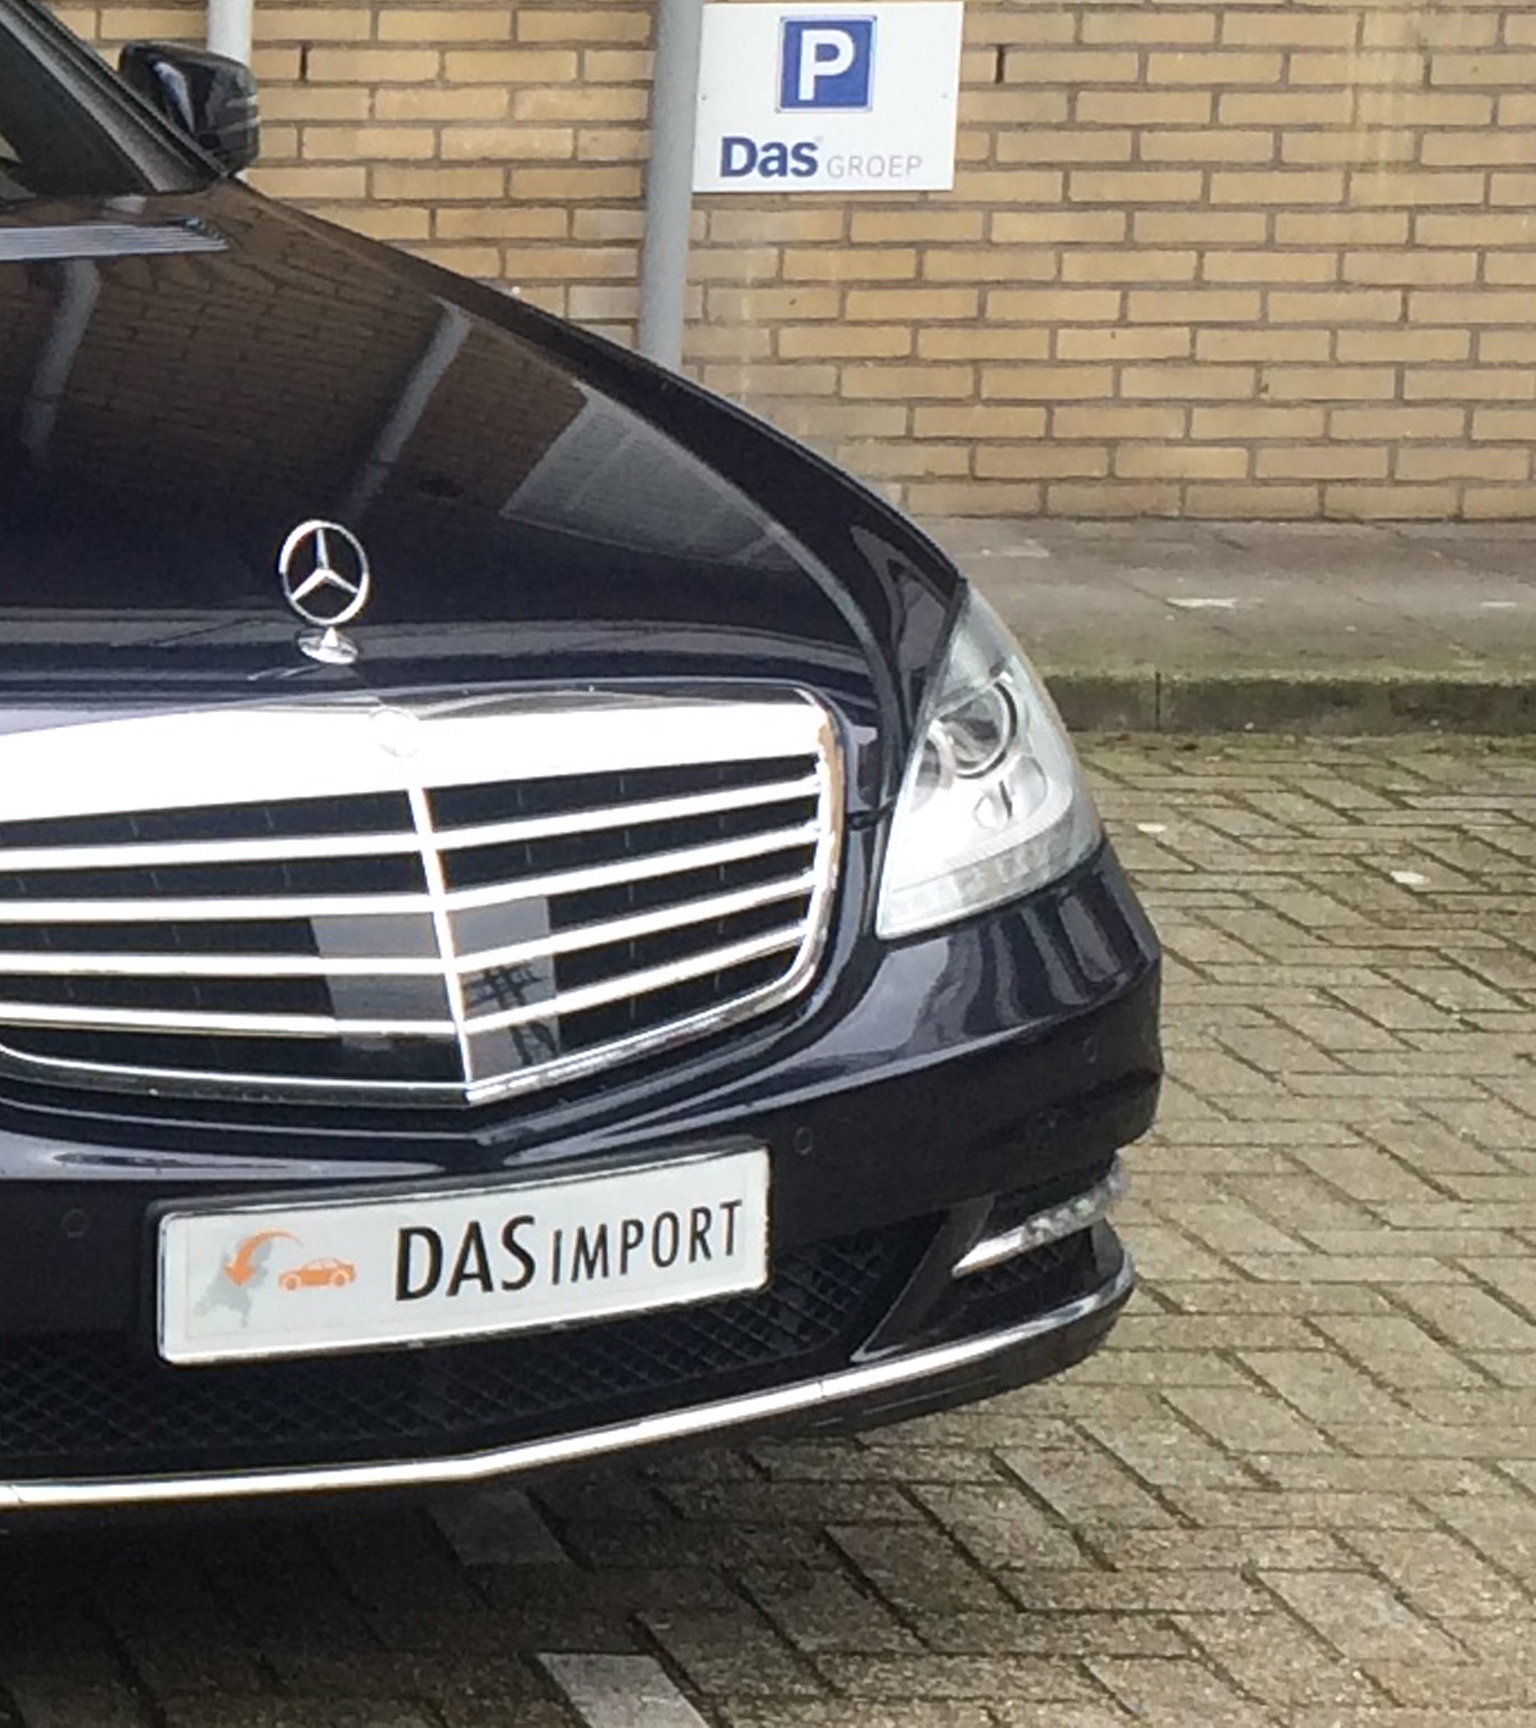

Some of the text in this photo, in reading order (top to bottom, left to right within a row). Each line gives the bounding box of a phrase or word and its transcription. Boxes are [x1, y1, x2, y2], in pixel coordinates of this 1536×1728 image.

[798, 29, 855, 101] P
[719, 136, 923, 179] Das GROEP
[395, 1200, 743, 1301] DAS IMPORT
